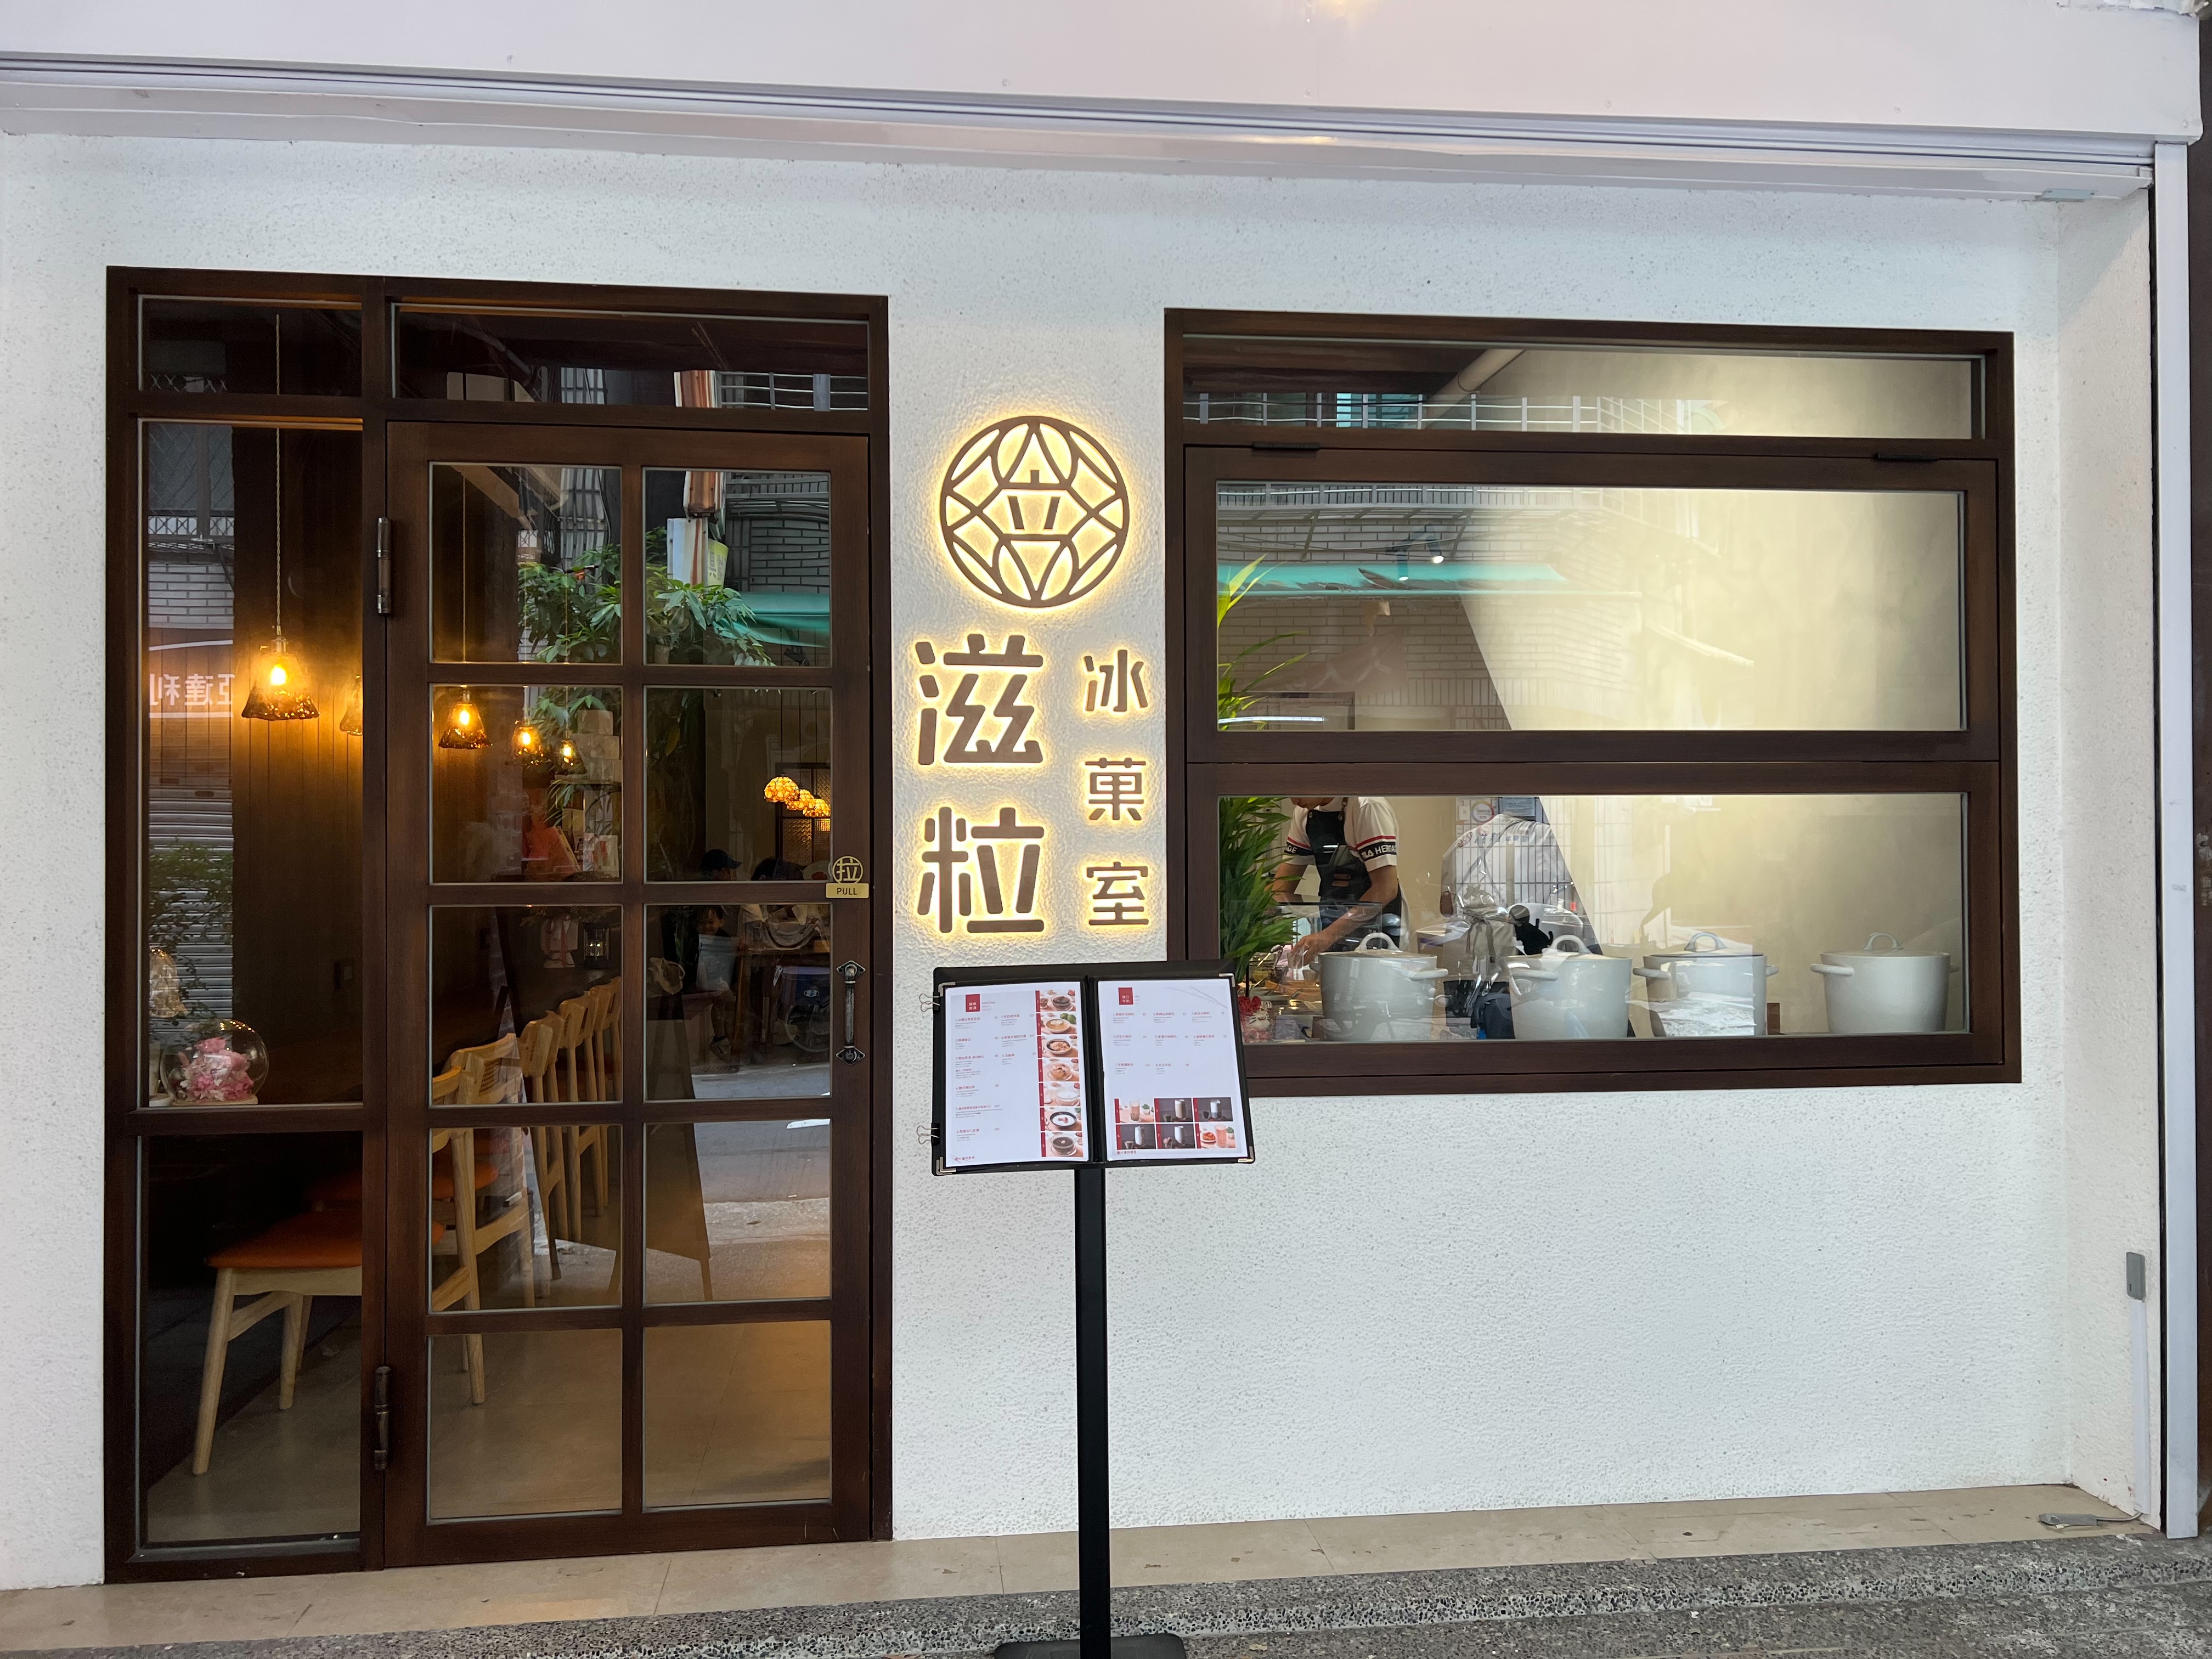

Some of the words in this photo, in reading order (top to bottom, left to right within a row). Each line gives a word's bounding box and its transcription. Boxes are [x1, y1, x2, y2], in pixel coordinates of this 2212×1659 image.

[915, 633, 1045, 933] 滋粒
[1084, 650, 1149, 926] 冰菓室
[836, 858, 860, 882] 拉
[837, 887, 857, 895] PULL
